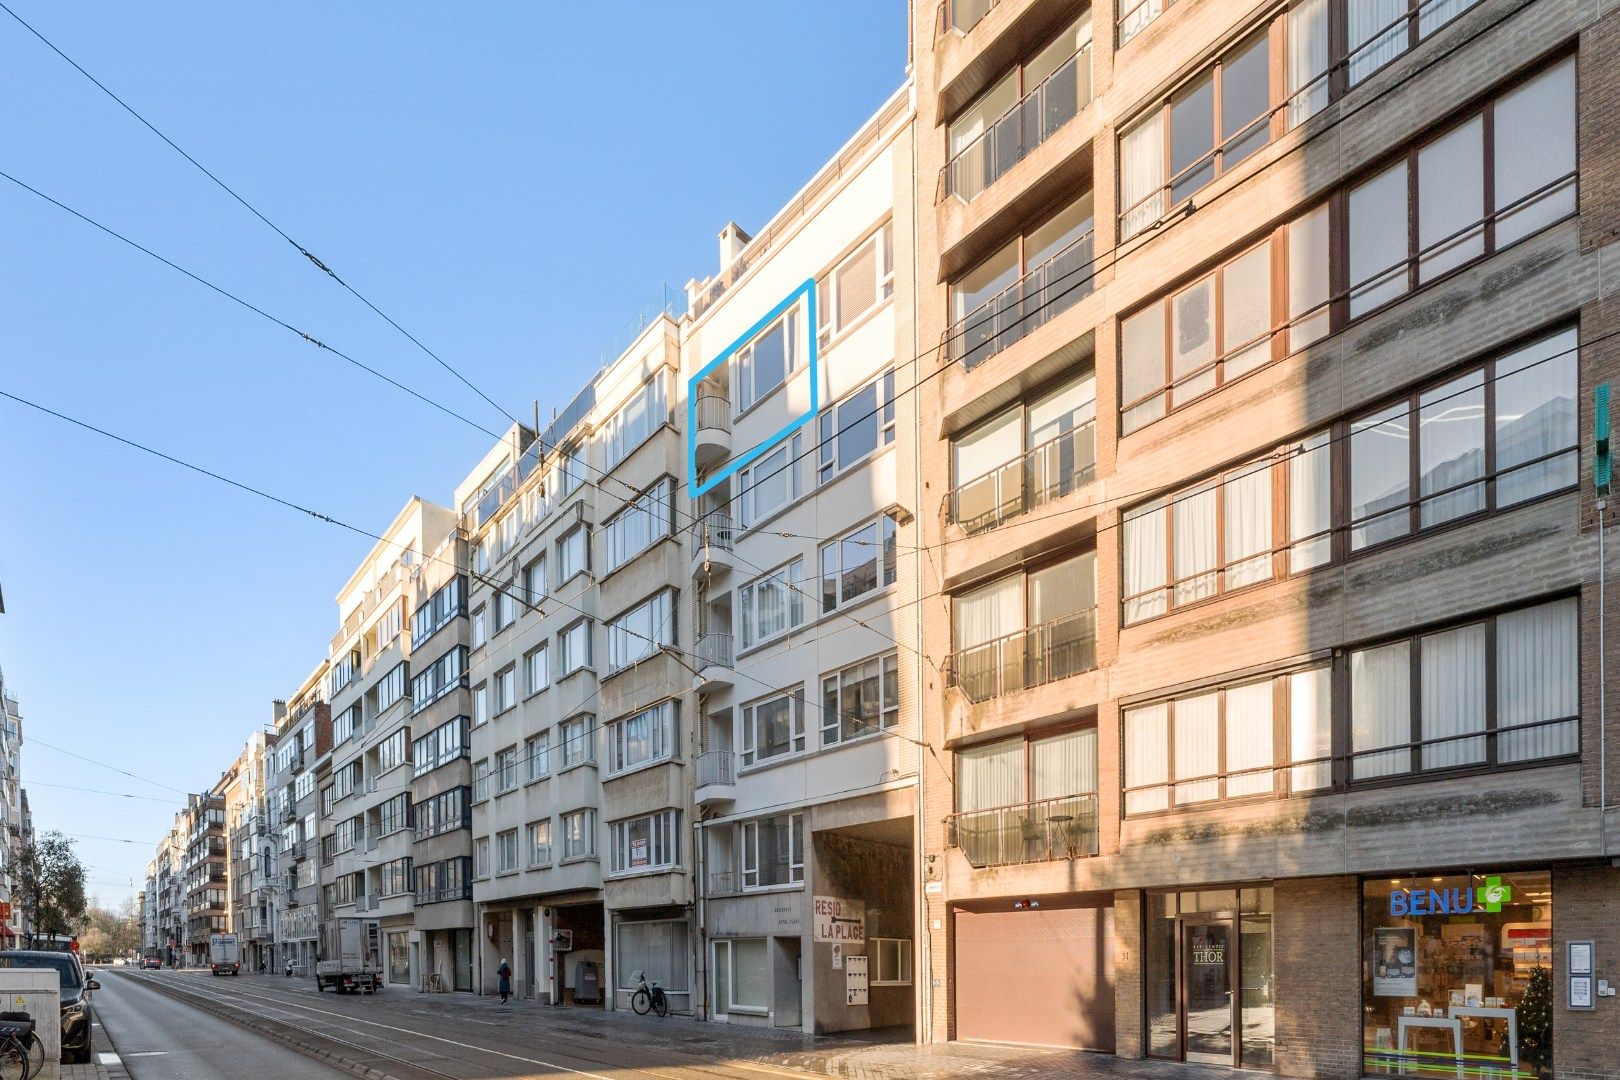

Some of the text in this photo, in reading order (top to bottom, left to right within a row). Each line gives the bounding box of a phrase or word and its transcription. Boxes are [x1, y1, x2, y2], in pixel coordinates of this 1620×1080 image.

[1390, 886, 1473, 916] BENU
[821, 924, 864, 940] LA PLAGE
[1193, 951, 1224, 963] THOR
